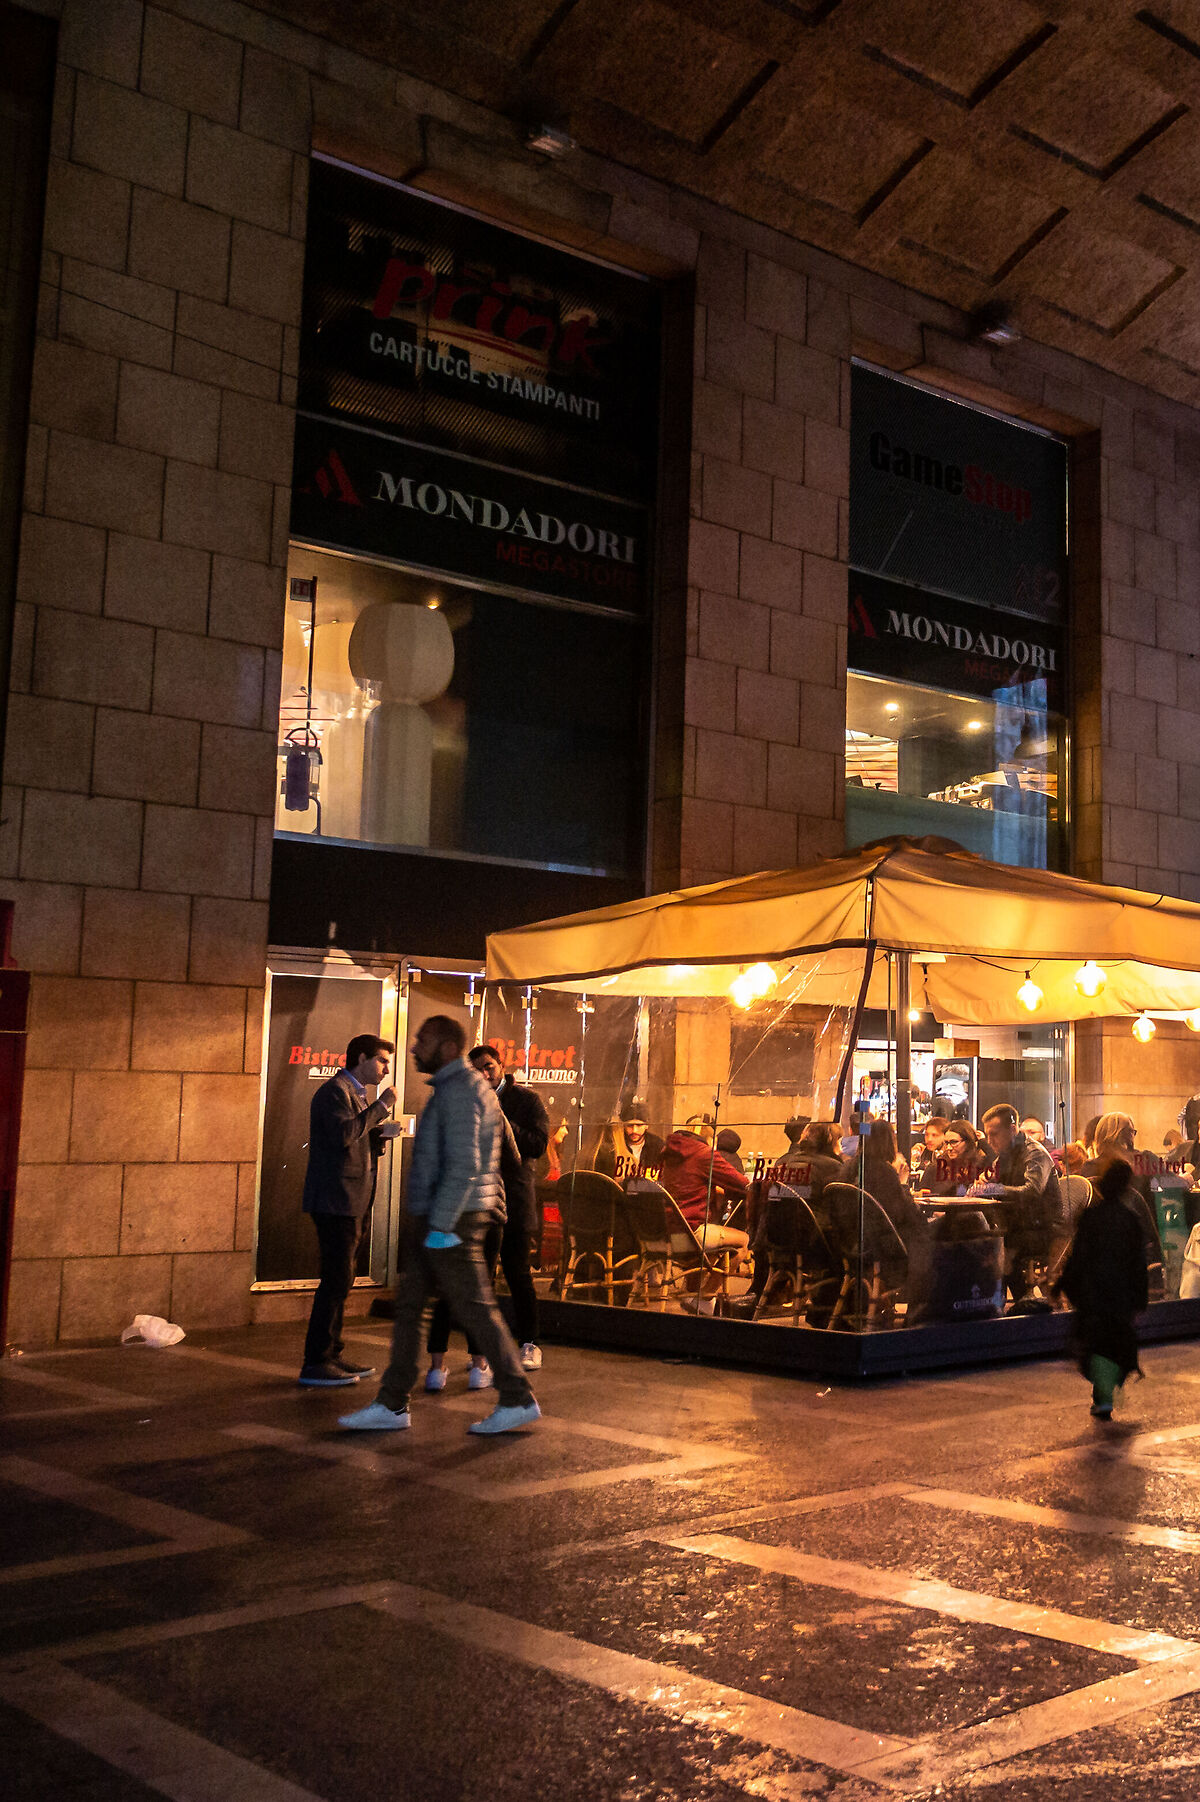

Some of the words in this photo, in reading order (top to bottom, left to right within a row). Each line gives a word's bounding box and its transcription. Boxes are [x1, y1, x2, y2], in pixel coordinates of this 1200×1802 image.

[369, 332, 481, 385] CARTUCCE
[486, 371, 600, 421] STAMPANTI
[869, 431, 1032, 523] GameStop
[371, 470, 640, 564] MONDADORI
[885, 608, 1057, 672] MONDADORI
[288, 1046, 347, 1067] Bistro
[488, 1038, 577, 1069] Bistrot
[614, 1155, 664, 1181] Bistrot
[752, 1158, 812, 1184] Bistrot
[1134, 1154, 1186, 1176] Bistrot
